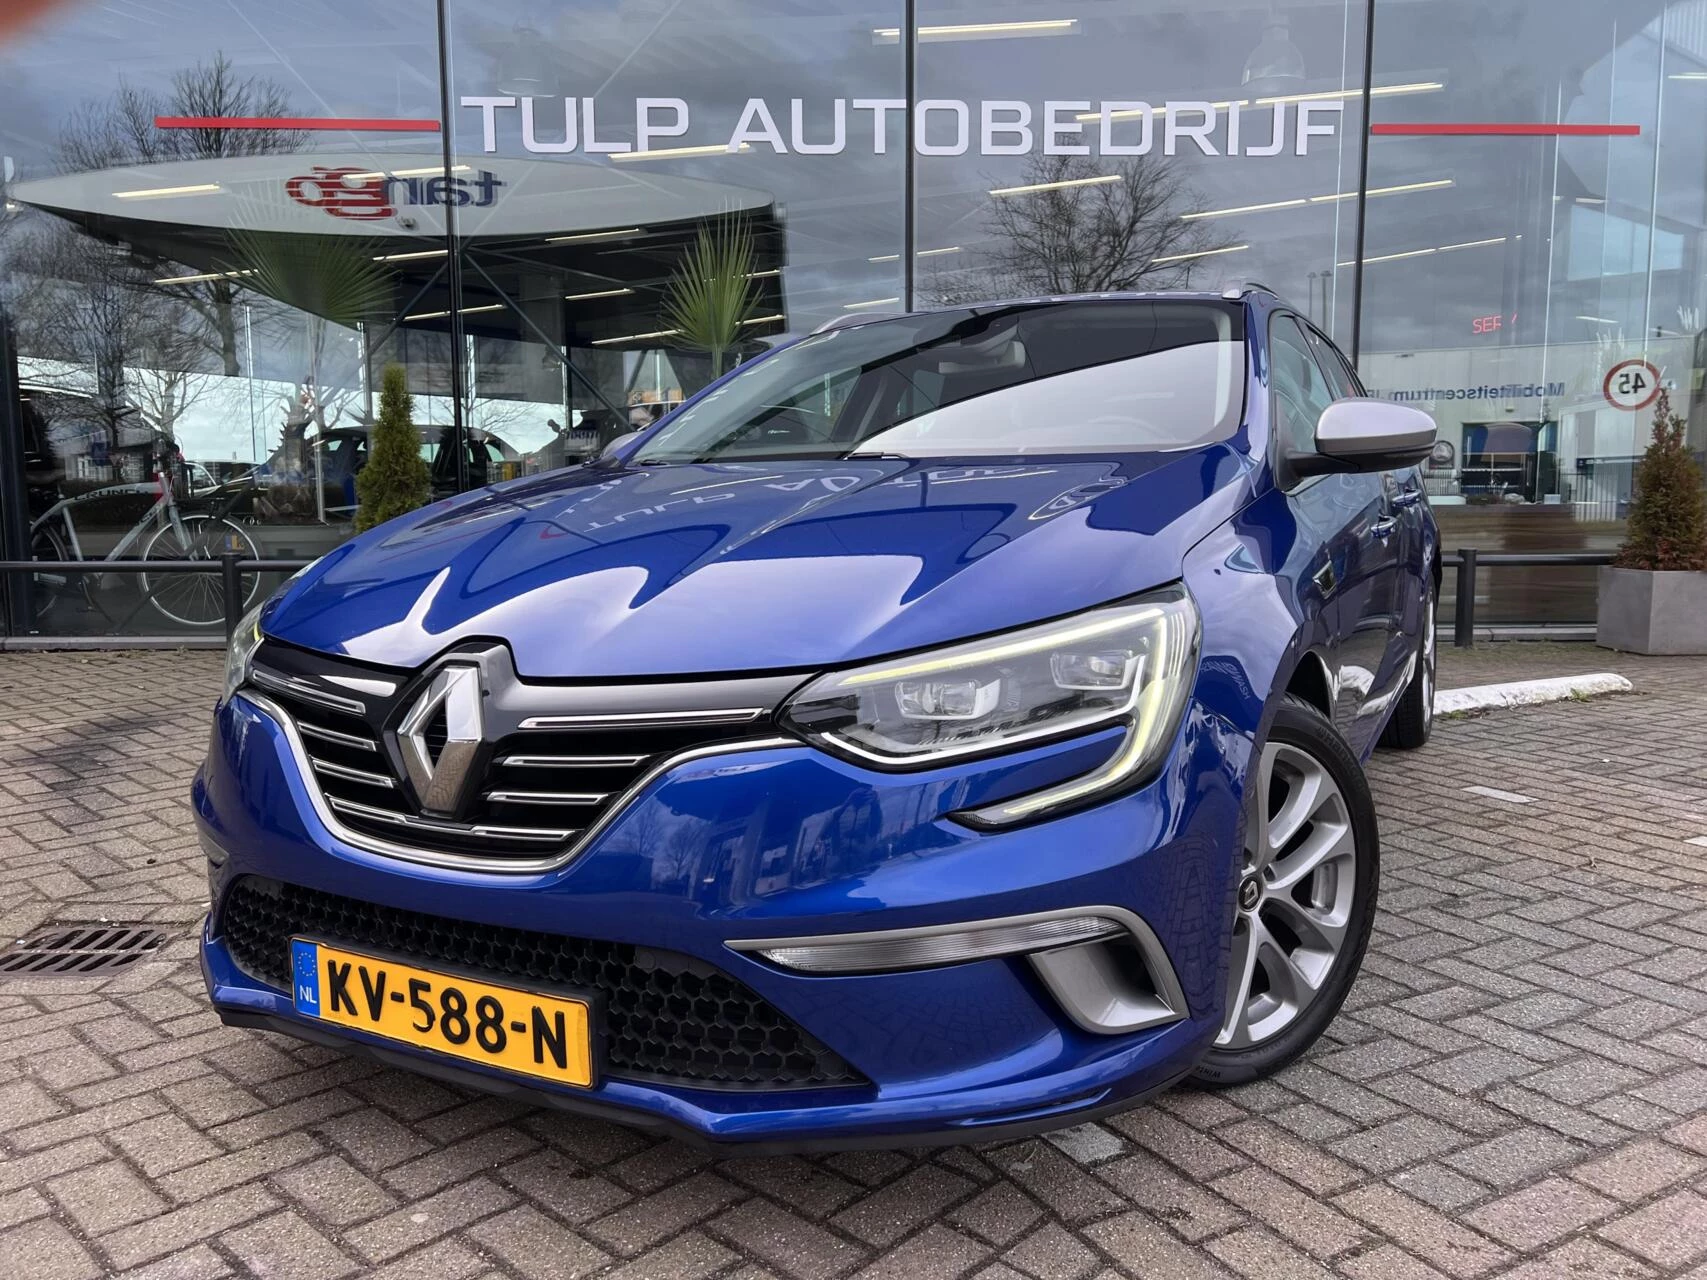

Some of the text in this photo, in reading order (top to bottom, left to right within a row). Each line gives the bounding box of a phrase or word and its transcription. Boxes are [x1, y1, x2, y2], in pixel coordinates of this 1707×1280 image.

[460, 95, 1345, 157] TULP AUTOBEDRIJF
[299, 985, 317, 1005] NL
[327, 959, 568, 1069] KV-588-N
